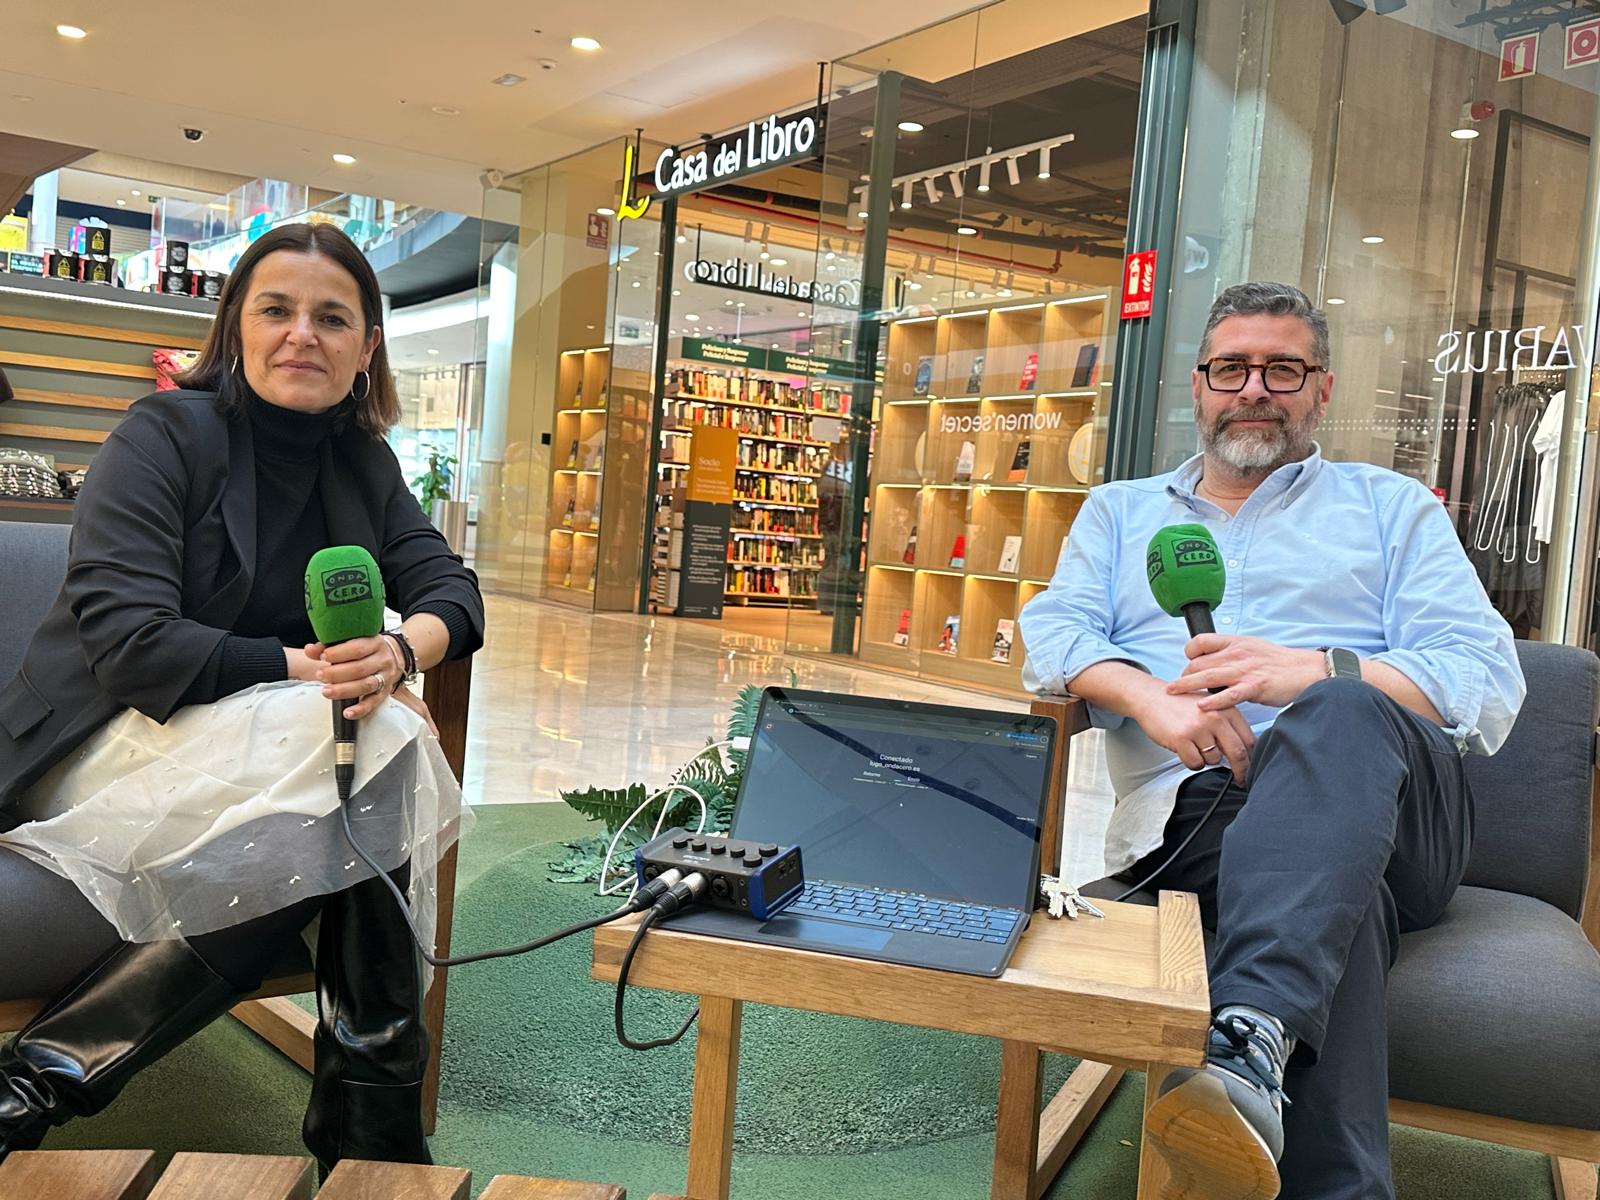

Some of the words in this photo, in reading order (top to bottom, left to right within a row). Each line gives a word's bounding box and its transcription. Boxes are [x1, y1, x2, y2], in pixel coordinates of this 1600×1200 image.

[654, 148, 708, 193] Casa
[712, 137, 743, 178] del
[746, 114, 816, 167] Libro
[1178, 542, 1210, 550] ONDA
[1183, 553, 1212, 561] CERO
[329, 574, 364, 584] ONDA
[333, 587, 366, 598] CERO
[879, 753, 914, 764] Conectado
